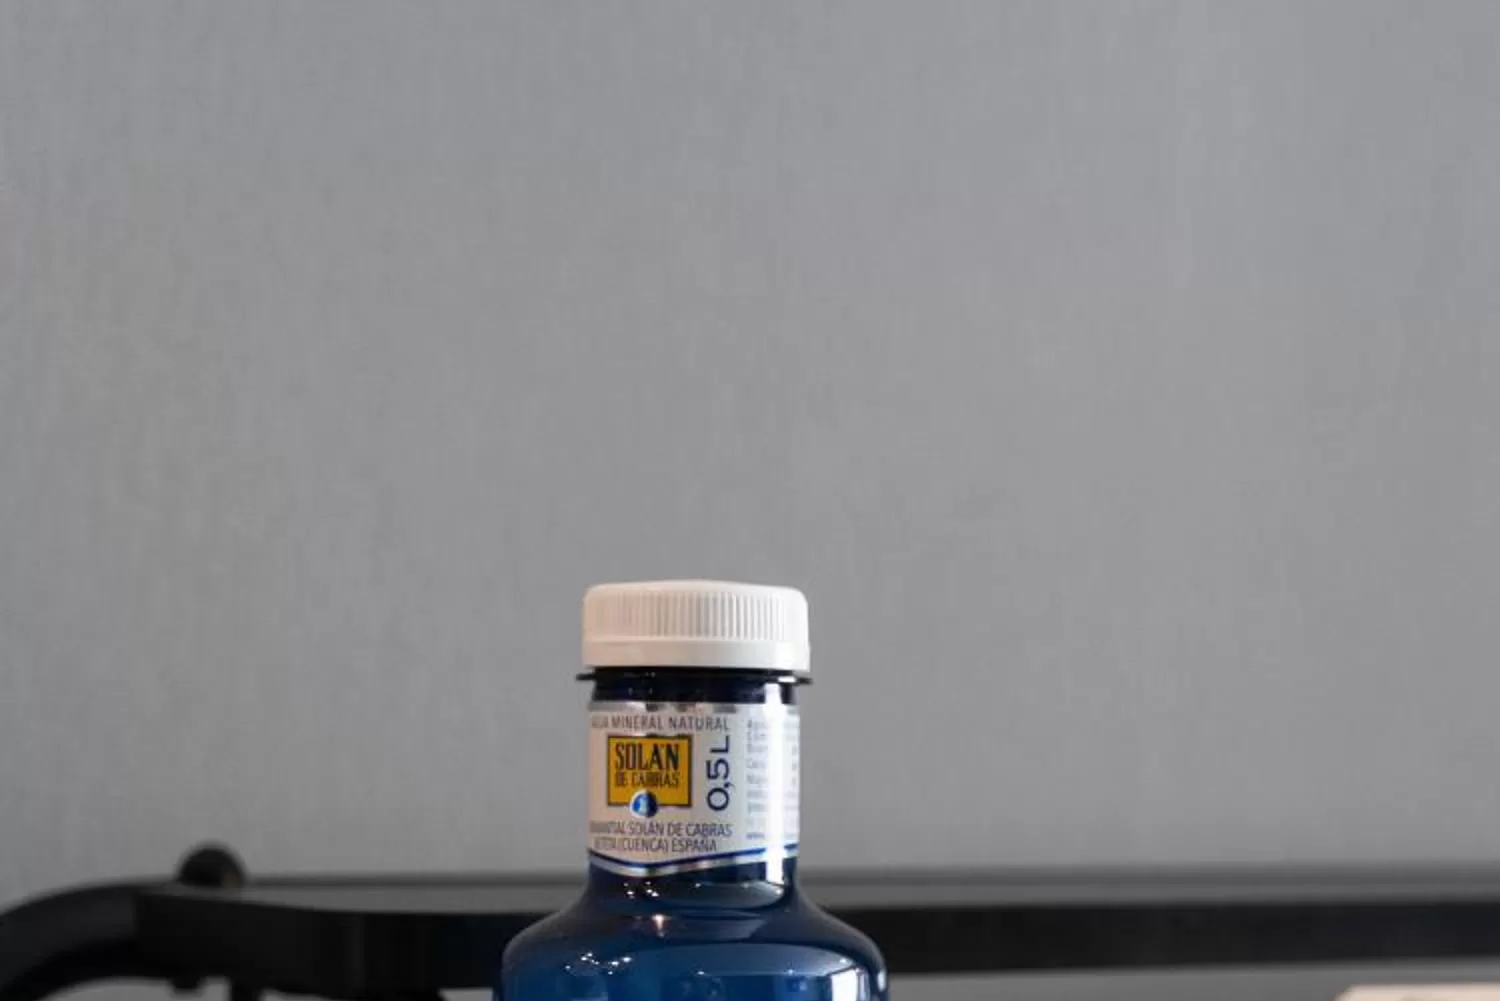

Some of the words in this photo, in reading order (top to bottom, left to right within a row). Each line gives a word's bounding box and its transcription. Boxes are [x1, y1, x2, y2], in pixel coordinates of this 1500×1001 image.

[611, 715, 664, 730] MINERAL
[669, 715, 730, 731] NATURAL
[631, 771, 680, 788] CABRAS
[668, 822, 684, 836] DE
[686, 823, 732, 837] CABRAS
